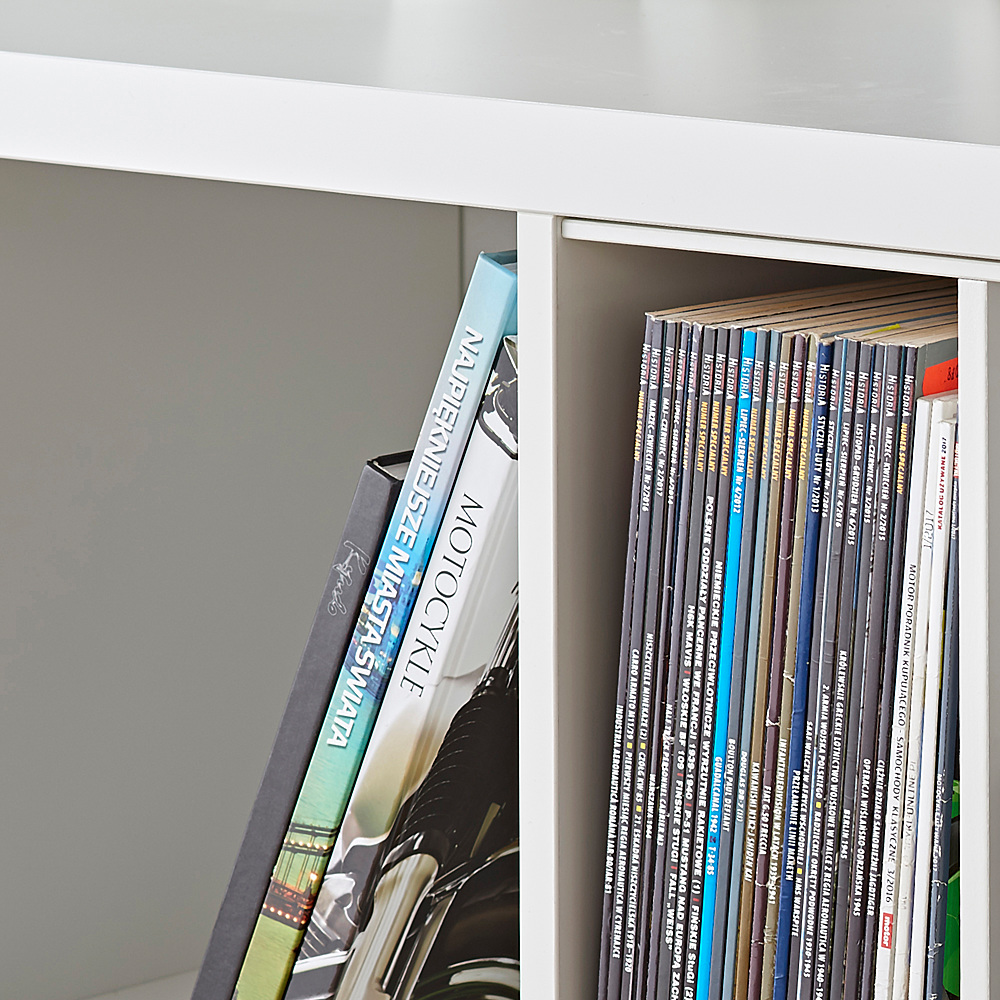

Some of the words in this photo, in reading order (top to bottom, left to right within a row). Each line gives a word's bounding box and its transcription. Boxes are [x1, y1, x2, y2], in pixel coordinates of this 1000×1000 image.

[649, 348, 660, 389] HISTORIA
[662, 346, 673, 388] HISTORIA
[701, 354, 713, 396] HISTORIA
[713, 353, 725, 395] HISTORIA
[725, 357, 738, 400] HISTORIA
[740, 357, 752, 399] HISTORIA
[752, 360, 763, 402] HISTORIA
[776, 362, 788, 404] HISTORIA
[789, 360, 802, 403] HISTORIA
[803, 361, 815, 403] HISTORIA
[817, 363, 829, 406] HISTORIA
[829, 369, 839, 411] HISTORIA
[843, 370, 855, 412] HISTORIA
[855, 371, 868, 414] HISTORIA
[870, 372, 881, 414] HISTORIA
[885, 374, 897, 417] HISTORIA
[901, 375, 913, 417] HISTORIA
[699, 401, 707, 429] NUMER
[711, 400, 719, 428] NUMER
[723, 405, 731, 433] NUMER
[749, 407, 757, 435] NUMER
[774, 409, 783, 437] NUMER
[787, 408, 796, 436] NUMER
[395, 326, 483, 549] NAJPIĘKNIEJSZE
[696, 430, 705, 472] SPECJALNY
[708, 429, 717, 472] SPECJALNY
[720, 434, 730, 476] SPECJALNY
[898, 422, 907, 451] NUMER
[746, 437, 755, 479] SPECJALNY
[771, 439, 781, 481] SPECJALNY
[784, 437, 793, 479] SPECJALNY
[798, 438, 806, 480] SPECJALNY
[896, 452, 905, 494] SPECJALNY
[641, 484, 650, 512] 2/2016
[655, 469, 664, 496] 2/2017
[732, 486, 741, 513] 4/2012
[810, 485, 819, 512] 1/2013
[703, 495, 713, 544] POLSKIE
[835, 499, 844, 527] 4/2016
[877, 513, 886, 540] 2/2015
[360, 545, 410, 645] MIASTA
[400, 493, 484, 698] MOTOCYKLE
[698, 547, 709, 603] ODDZIAŁY
[710, 560, 722, 627] NIEMIECKIE
[906, 564, 916, 601] MOTOR
[683, 630, 693, 667] MAVIS
[694, 605, 705, 667] PANCERNE
[902, 603, 912, 656] PORADNIK
[630, 648, 639, 675] CARRO
[642, 632, 653, 689] NISZCZYCIELE
[692, 670, 700, 687] WE
[836, 650, 848, 700] KRÓLEWSKIE
[327, 645, 378, 747] ŚWIATA
[628, 676, 637, 710] ARMATO
[679, 677, 689, 728] WŁOSKIE
[703, 630, 717, 737] PRZECIWLOTNICZE
[896, 659, 909, 726] KUPUJĄCEGO
[613, 704, 623, 750] INDUSTRIA
[640, 688, 649, 727] MINEKAZE
[688, 690, 699, 739] FRANCJI
[820, 693, 828, 719] ARMIA
[833, 701, 843, 735] GRECKIE
[678, 731, 686, 746] BF
[725, 738, 735, 775] BOULTON
[802, 742, 811, 773] WALCZY
[817, 721, 826, 754] WOJSKA
[622, 751, 632, 791] PIERWSZY
[659, 751, 669, 797] PERSONNEL
[676, 750, 684, 769] 109
[685, 743, 695, 799] 1939-1940
[698, 740, 710, 807] WYRZUTNIE
[815, 754, 824, 798] POLSKIEGO
[830, 736, 840, 782] LOTNICTWO
[861, 758, 870, 798] OPERACJA
[892, 736, 903, 800] SAMOCHODY
[646, 773, 655, 818] WARSZAWA
[711, 756, 722, 812] GUADALCANAL
[748, 761, 759, 808] KAWANISHI
[789, 769, 800, 826] PRZEŁAMANIE
[800, 784, 808, 812] AFRYCE
[873, 790, 882, 819] DZIAŁO
[657, 798, 666, 832] CARRIER
[682, 809, 690, 833] P-51
[709, 814, 717, 833] 1942
[722, 797, 731, 831] DEFIANT
[827, 783, 837, 828] WOJSKOWE
[842, 808, 850, 838] BERLIN
[619, 825, 627, 848] REGIA
[631, 828, 640, 864] ESKADRA
[670, 827, 679, 862] STUGI
[693, 809, 705, 876] RAKIETOWE
[745, 836, 753, 867] SHIDEN
[758, 823, 767, 855] FRECCIA
[796, 814, 806, 864] WSCHODNIEJ
[811, 810, 820, 856] RADZIECKIE
[824, 839, 833, 865] WALCE
[887, 806, 898, 863] KLASYCZNE
[615, 849, 626, 905] AERONAUTICA
[678, 837, 688, 892] MUSTANG
[785, 847, 794, 881] MARETH
[808, 857, 817, 888] OKRĘTY
[822, 871, 830, 896] REGIA
[627, 864, 638, 928] NISZCZYCIELSKA
[667, 872, 676, 899] FALL
[884, 869, 894, 903] 3/2016
[676, 895, 684, 920] NAD
[688, 904, 701, 950] FIŃSKIE
[791, 896, 800, 936] WARSPITE
[805, 889, 815, 936] PODWODNE
[818, 896, 829, 952] AERONAUTICA
[612, 914, 622, 958] CYRENAJCE
[671, 922, 682, 969] EUROPĄ
[882, 915, 891, 947] motor
